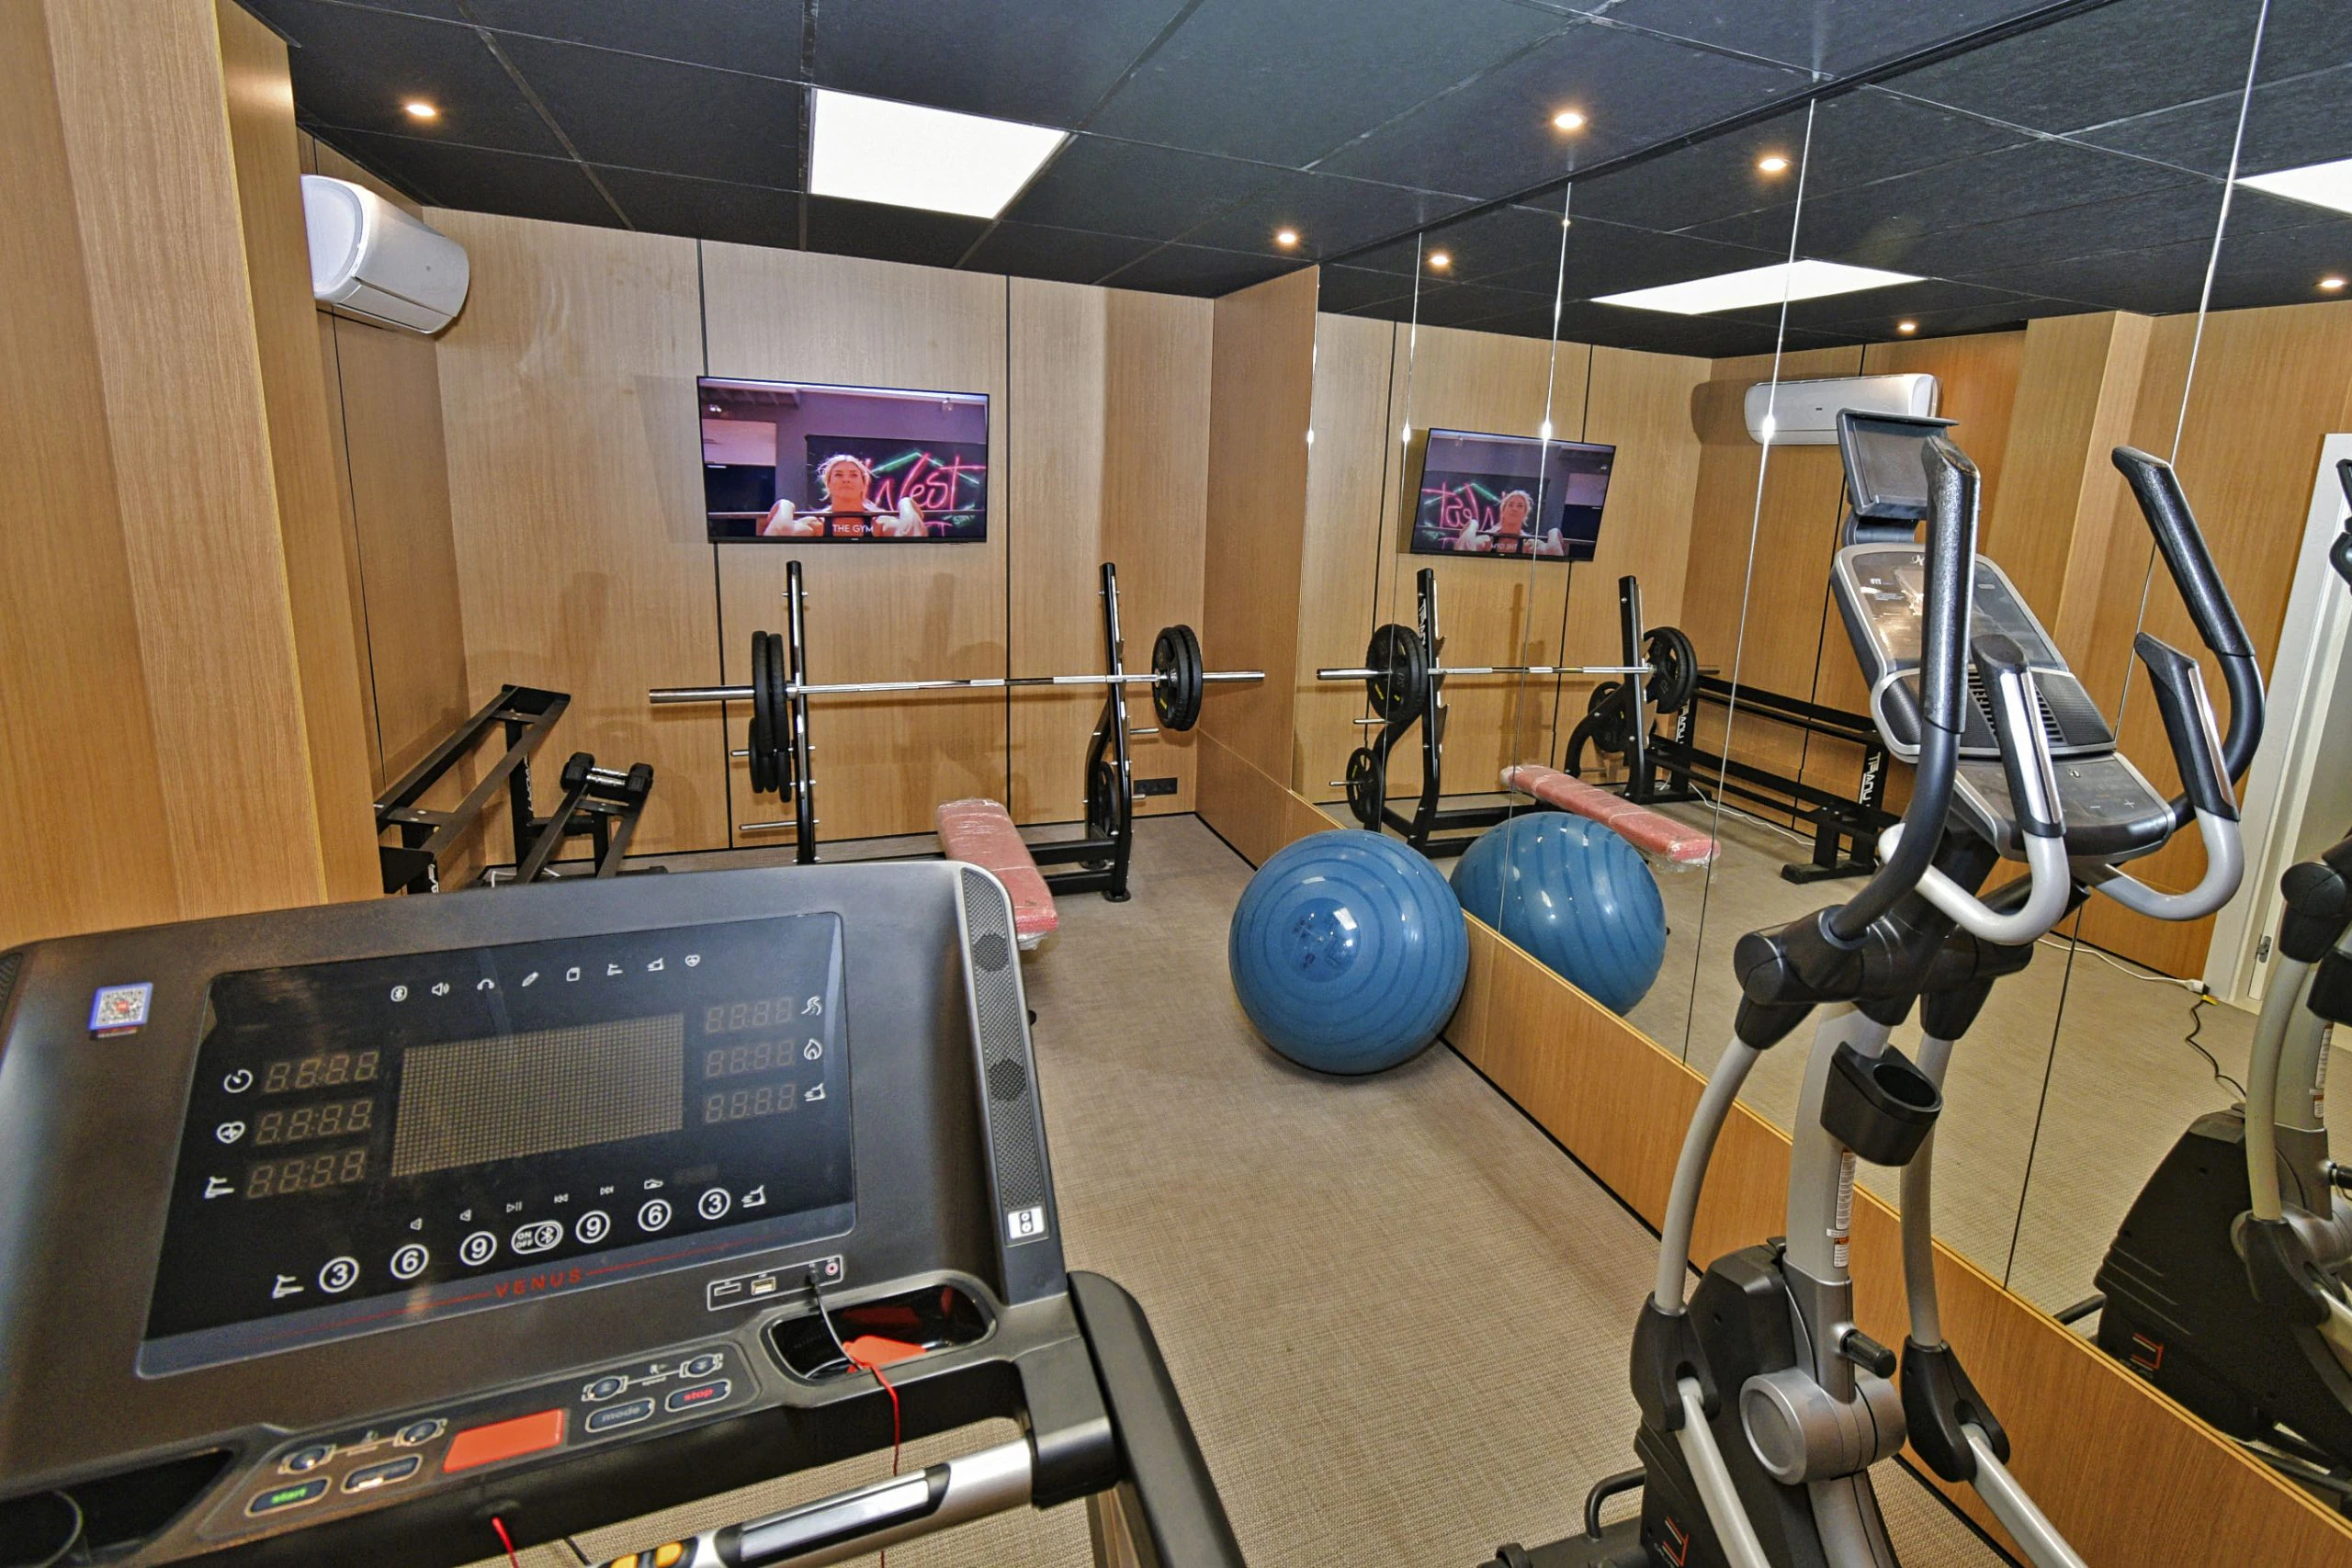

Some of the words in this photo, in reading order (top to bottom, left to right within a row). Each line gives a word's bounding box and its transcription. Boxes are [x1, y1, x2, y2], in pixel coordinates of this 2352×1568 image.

[831, 524, 850, 533] THE
[852, 524, 874, 533] GYM
[708, 1194, 722, 1213] 3
[648, 1205, 662, 1226] 6
[517, 1231, 533, 1240] ON
[585, 1217, 602, 1237] 9
[470, 1237, 488, 1259] 9
[515, 1240, 533, 1248] OFF
[401, 1250, 419, 1272] 6
[330, 1263, 348, 1286] 3
[495, 1268, 582, 1298] VENUS
[684, 1387, 714, 1402] stop
[602, 1405, 641, 1422] mode
[271, 1486, 308, 1505] start
